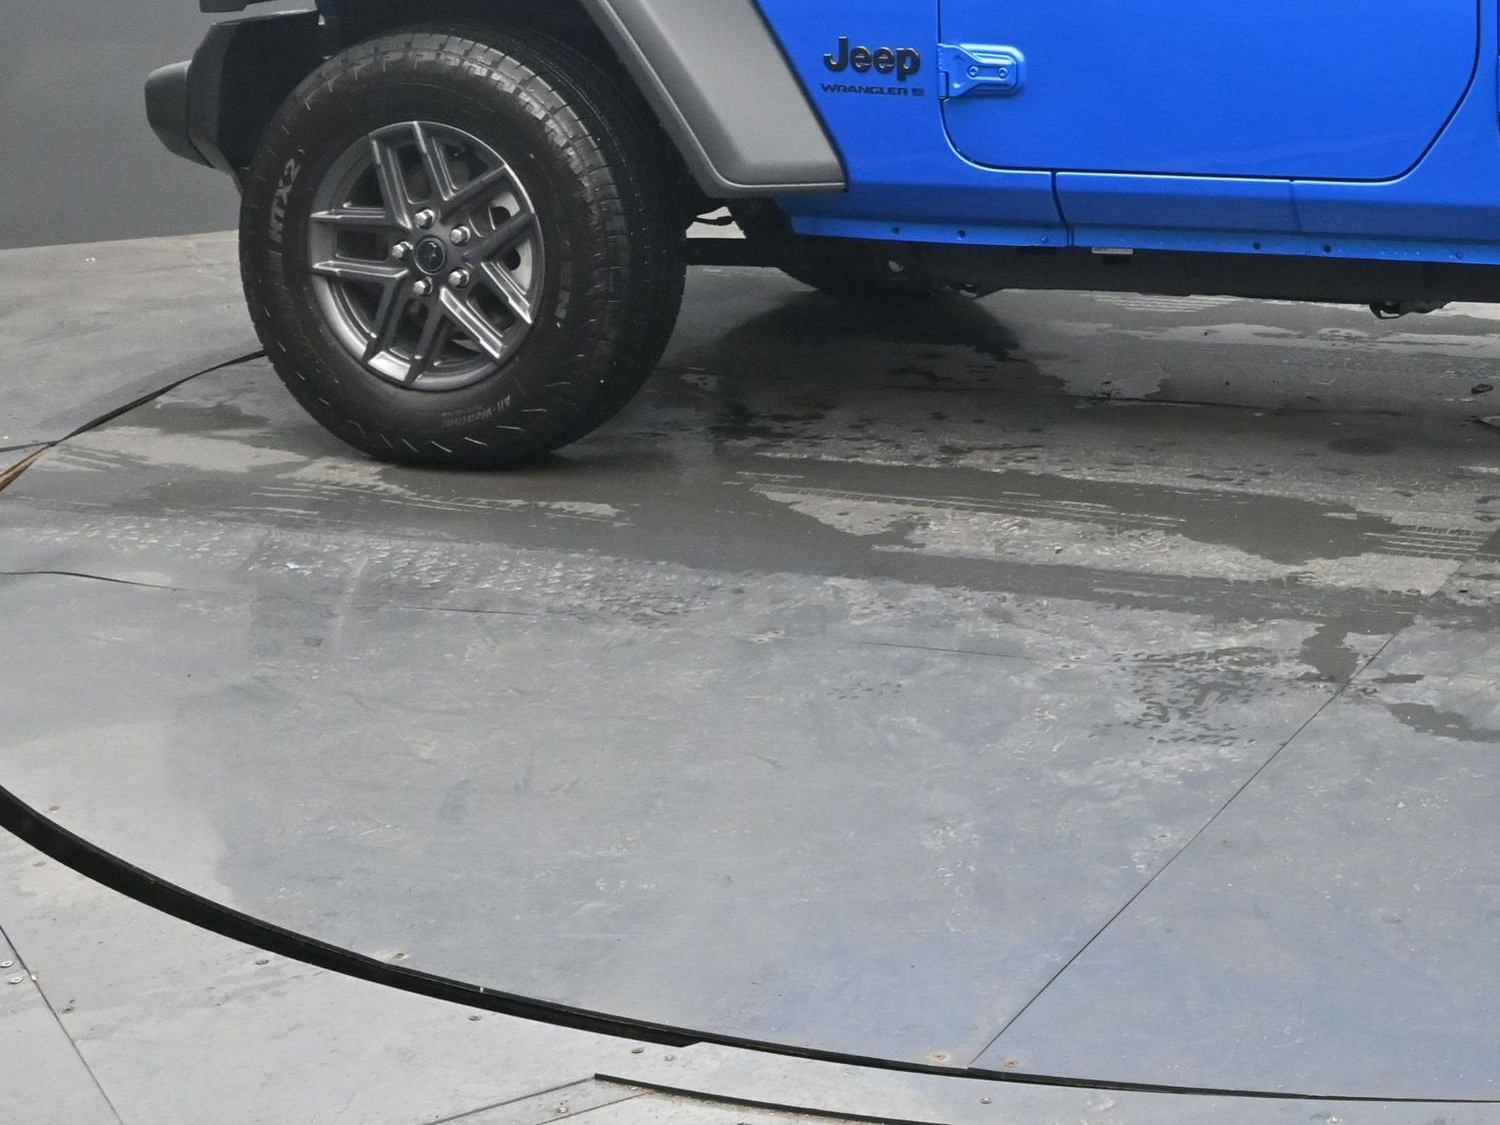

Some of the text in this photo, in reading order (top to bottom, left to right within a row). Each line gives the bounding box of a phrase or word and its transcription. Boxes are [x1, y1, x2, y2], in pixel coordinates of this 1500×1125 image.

[823, 36, 920, 81] Jeep
[820, 83, 908, 96] WRANGLER
[268, 158, 301, 243] HTX2
